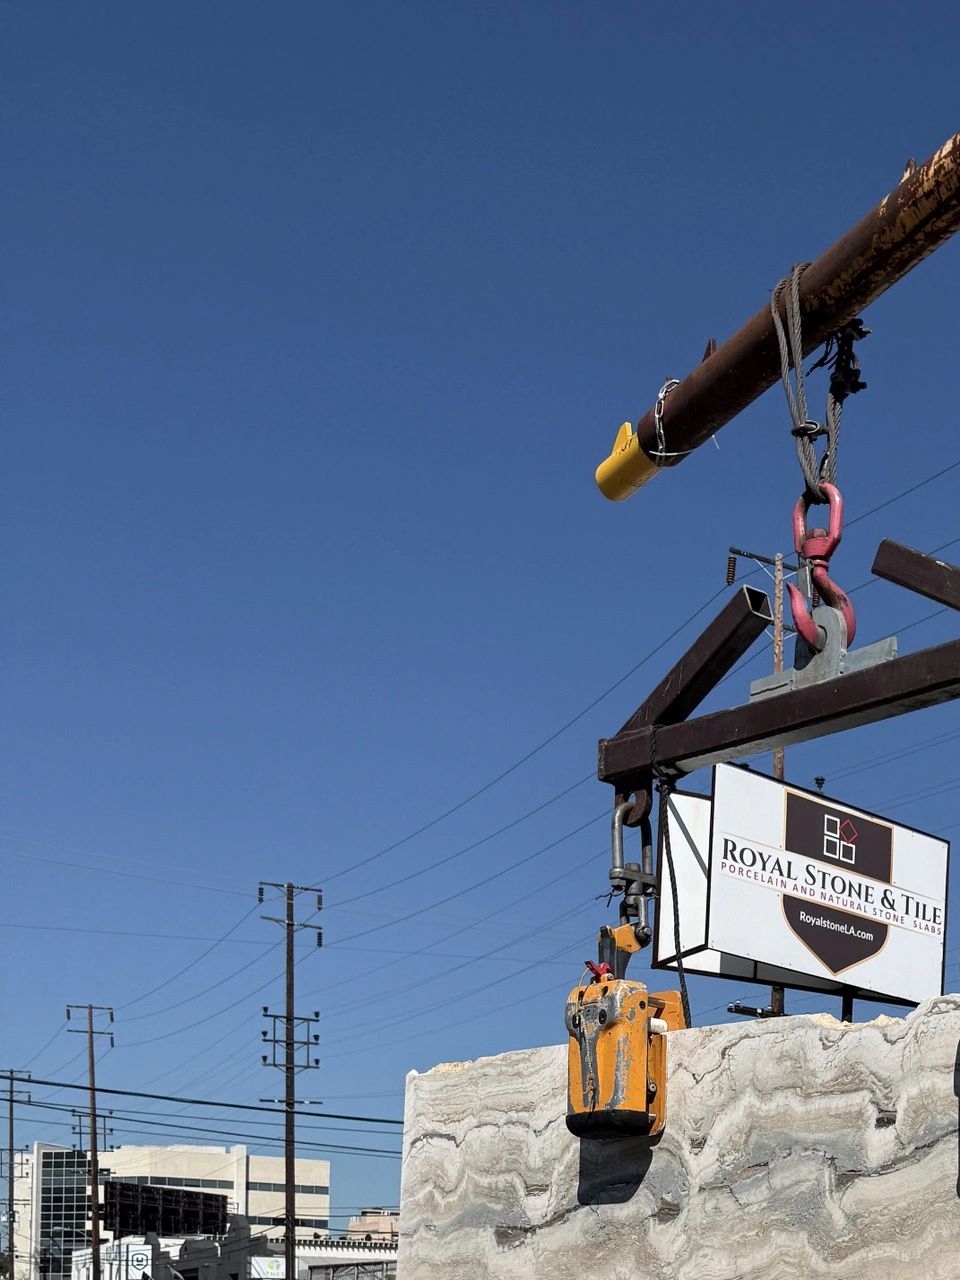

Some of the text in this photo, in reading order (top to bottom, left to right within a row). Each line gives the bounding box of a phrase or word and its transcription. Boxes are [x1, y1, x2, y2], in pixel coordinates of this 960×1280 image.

[721, 861, 942, 936] PORCELAIN AND NATURAL STONE SLABS
[722, 838, 942, 926] ROYAL STONE & TILE
[799, 910, 874, 942] RoyalstoneLA.com
